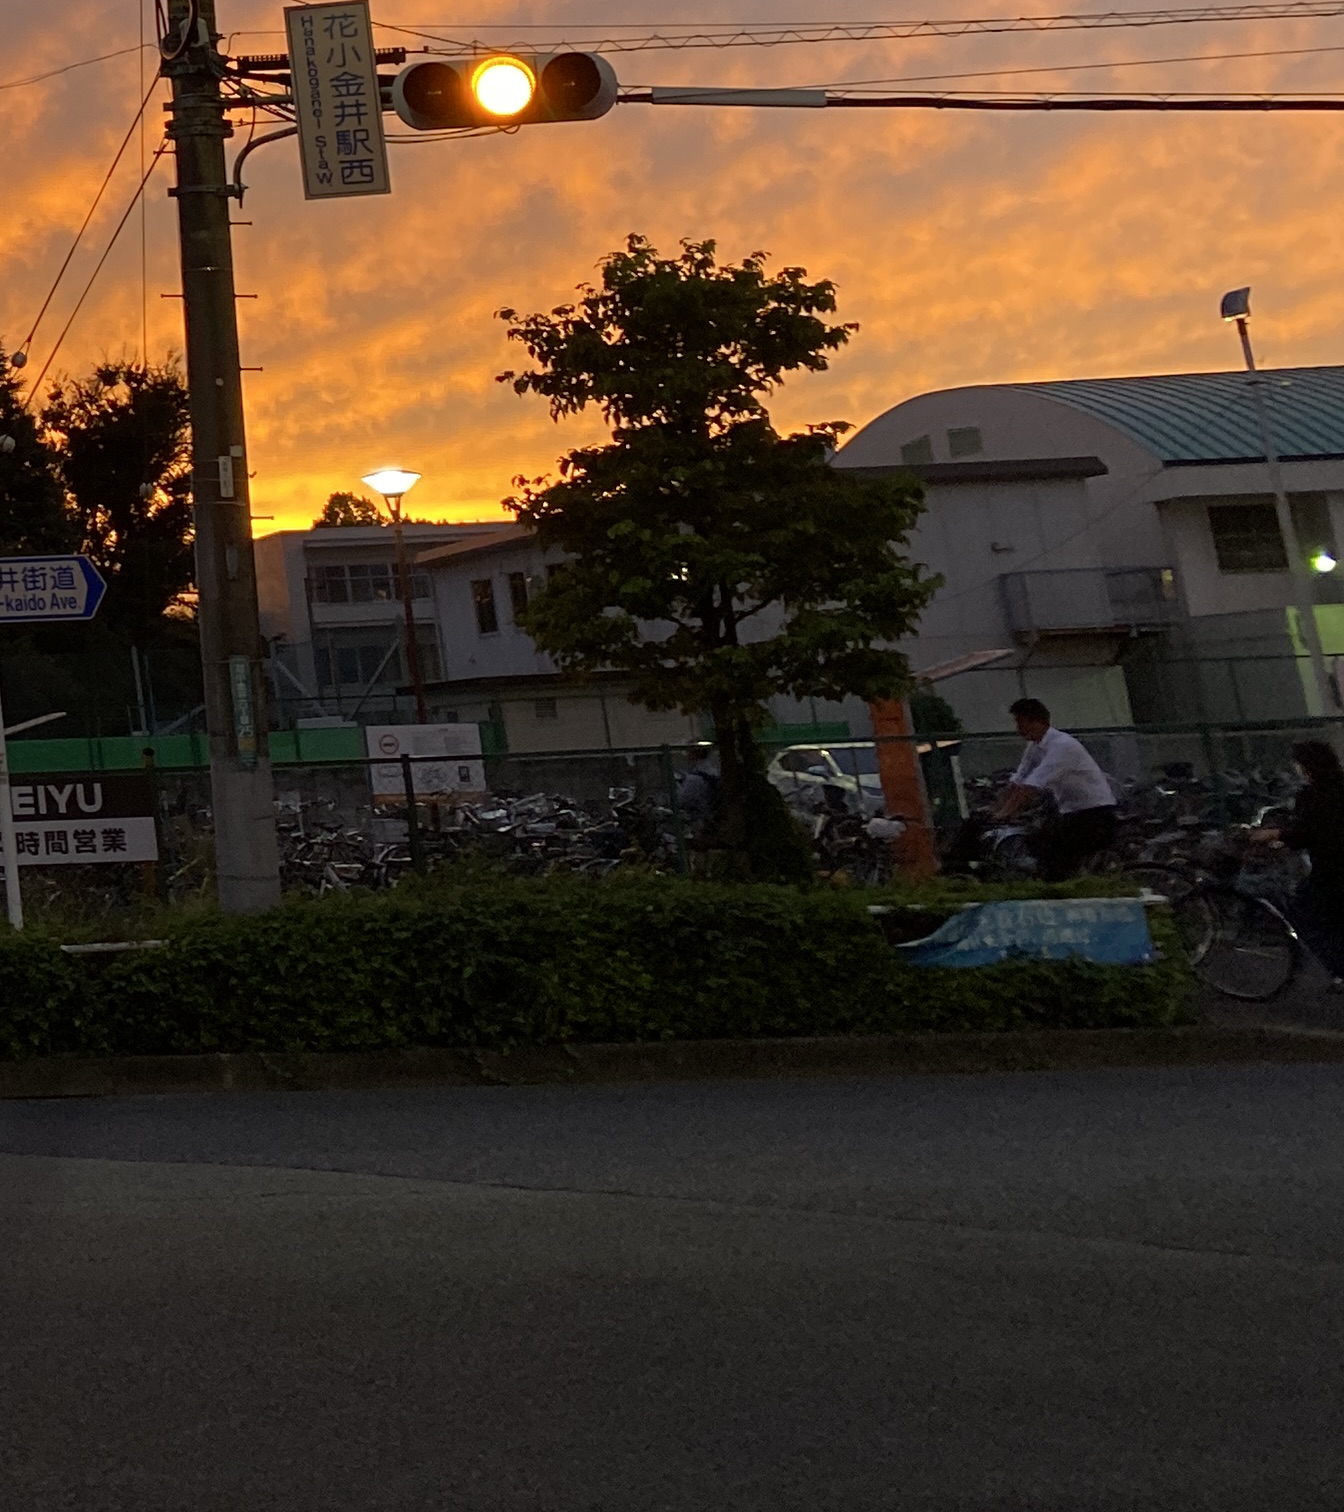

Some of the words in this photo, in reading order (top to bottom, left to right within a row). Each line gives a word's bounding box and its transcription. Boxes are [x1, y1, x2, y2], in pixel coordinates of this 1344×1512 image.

[300, 15, 322, 129] Hanakoganei
[323, 13, 375, 185] 花小金井駅西
